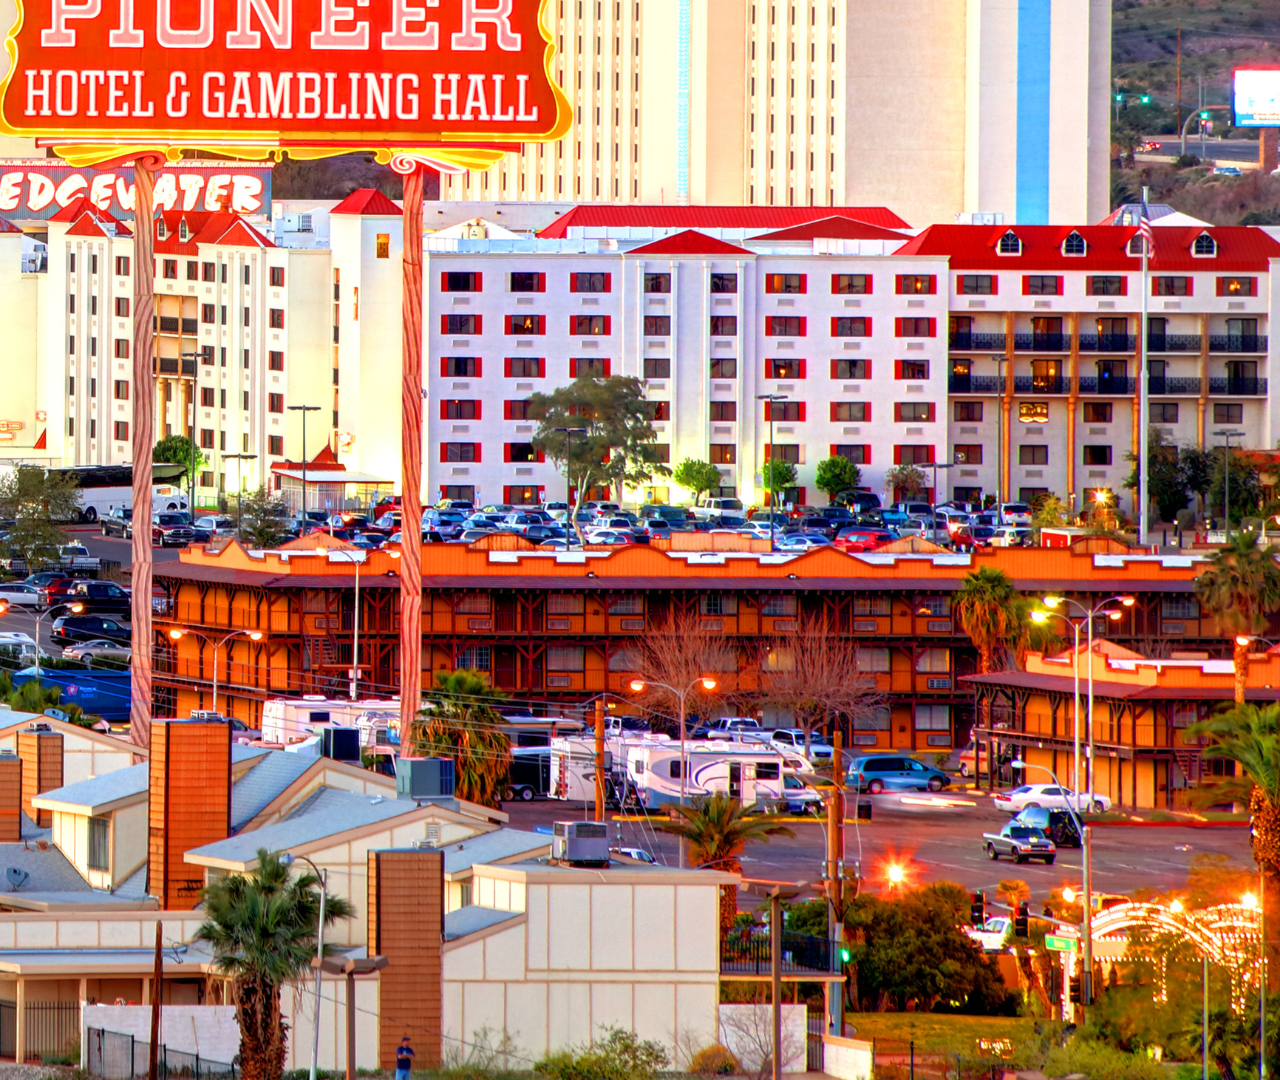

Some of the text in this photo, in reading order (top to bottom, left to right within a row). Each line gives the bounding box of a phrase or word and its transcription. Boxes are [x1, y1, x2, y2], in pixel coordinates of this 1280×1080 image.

[24, 69, 539, 122] HOTEL & GAMBLING HALL
